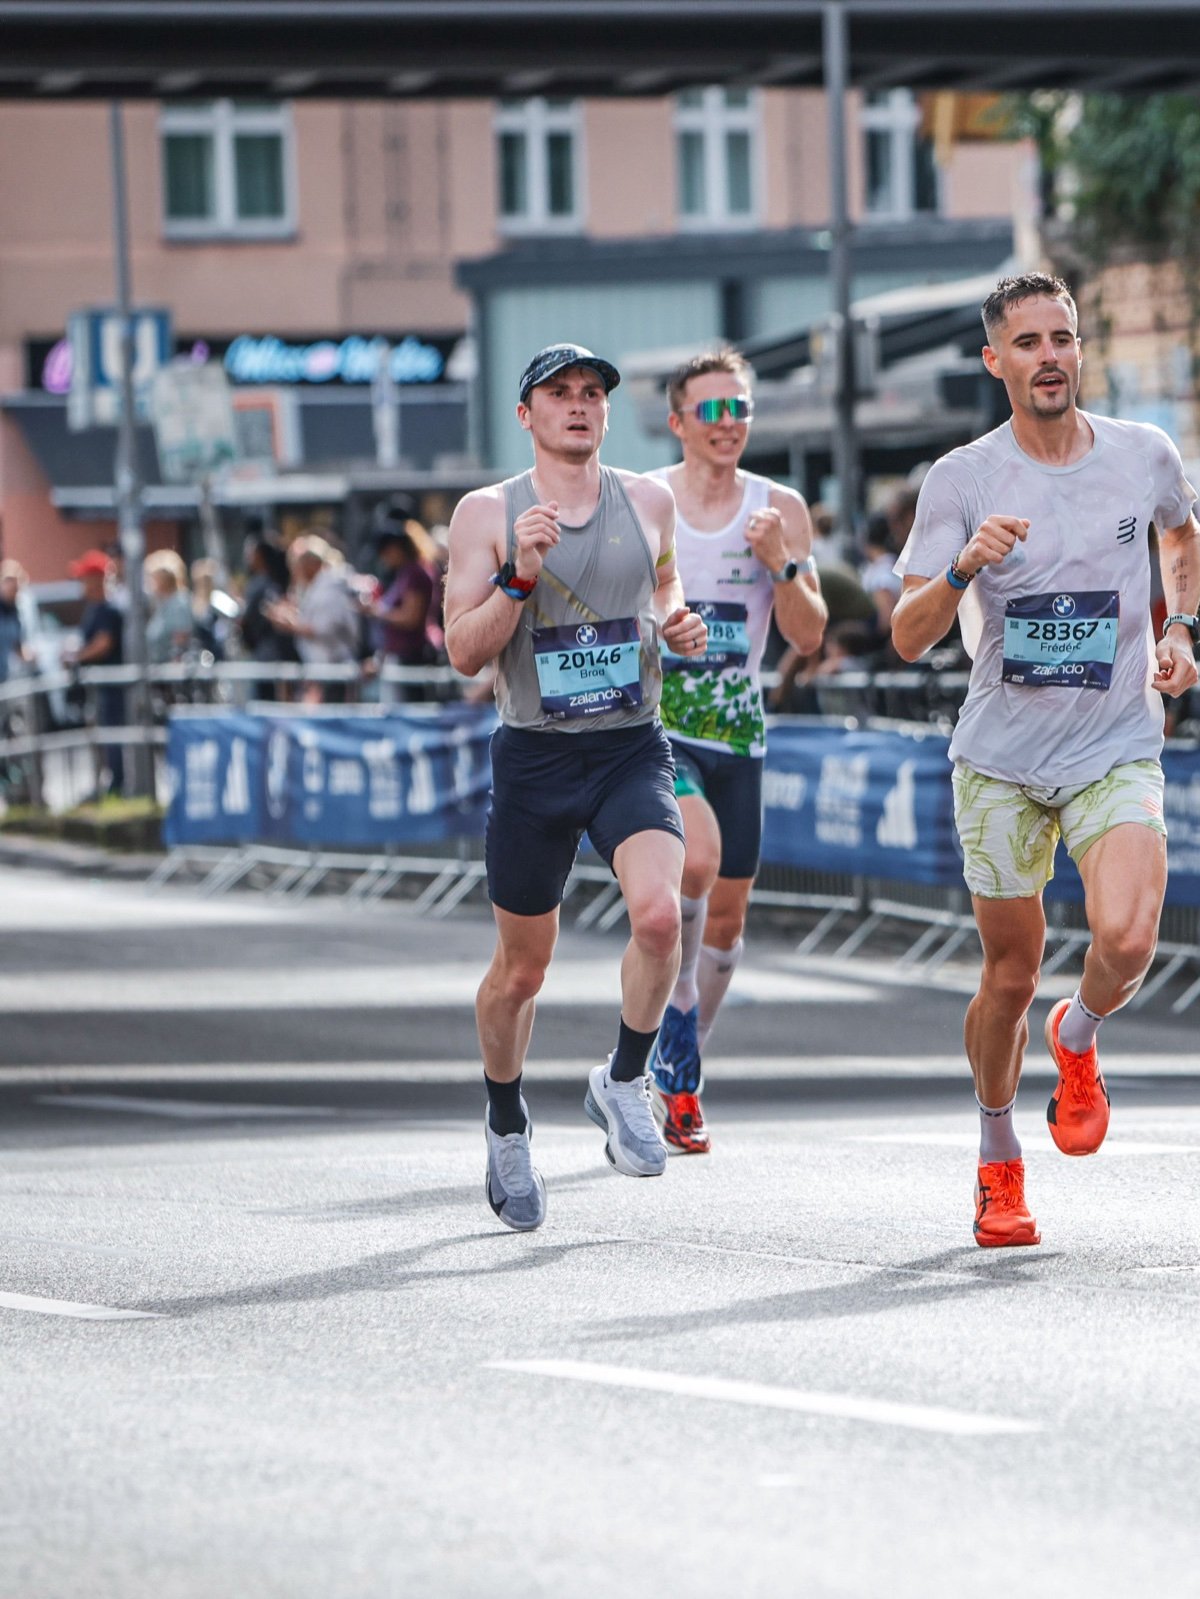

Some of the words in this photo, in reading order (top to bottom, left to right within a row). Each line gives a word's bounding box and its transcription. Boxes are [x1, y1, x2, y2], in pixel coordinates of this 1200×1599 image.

[100, 317, 158, 384] U
[1026, 621, 1099, 641] 28367
[1040, 641, 1082, 653] Frédérc
[558, 647, 621, 671] 20146
[569, 687, 622, 707] zalando
